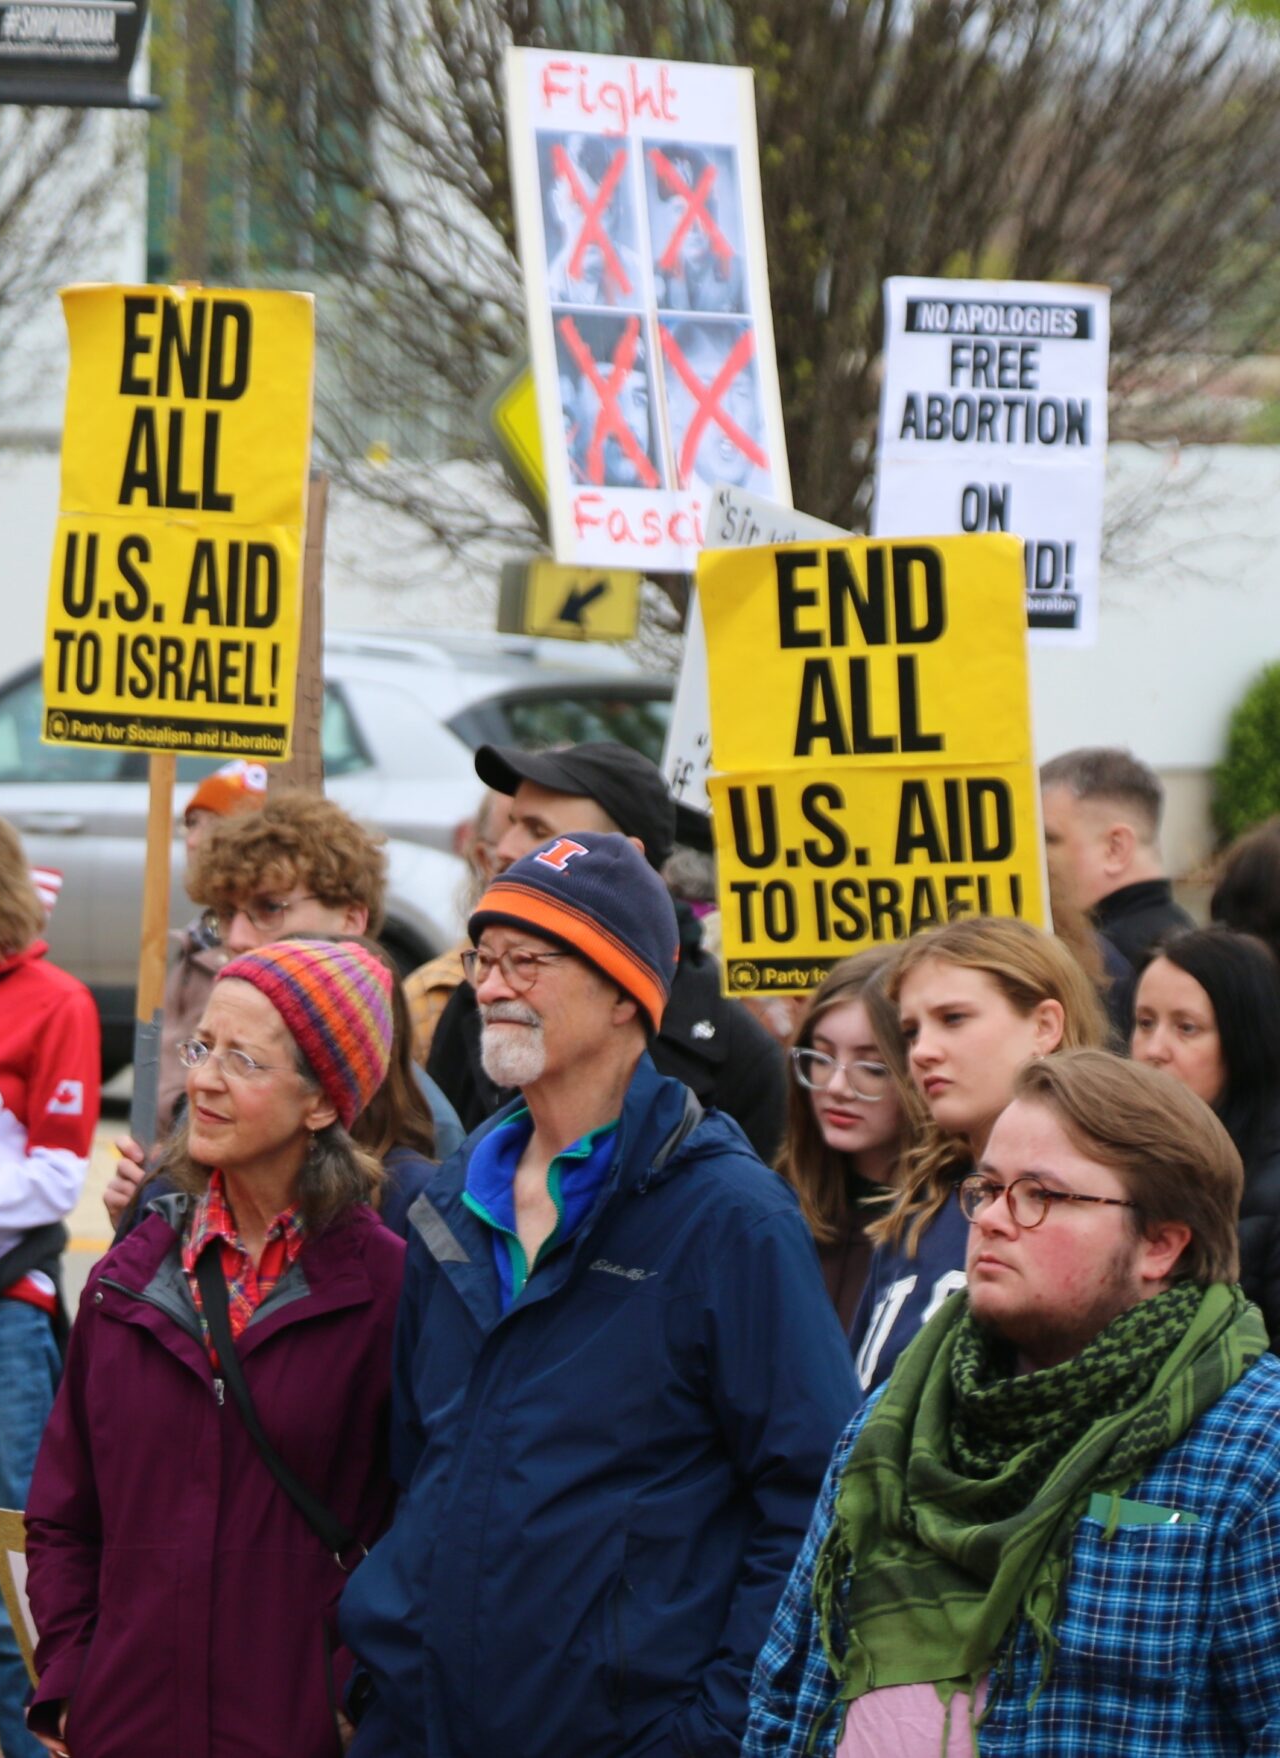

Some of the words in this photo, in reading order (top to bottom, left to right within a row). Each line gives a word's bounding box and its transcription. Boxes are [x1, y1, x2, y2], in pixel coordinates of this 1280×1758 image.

[541, 60, 680, 138] Fight
[118, 294, 254, 402] END
[919, 302, 950, 331] NO
[953, 303, 1079, 338] APOLOGIES
[949, 338, 1043, 391] FREE
[899, 391, 1092, 447] ABORTION
[117, 404, 236, 513] ALL
[960, 480, 1012, 534] ON
[61, 532, 165, 623] U.S.
[182, 538, 281, 629] AID
[773, 543, 950, 650] END
[53, 628, 103, 698] TO
[115, 632, 281, 708] ISRAEL!
[73, 719, 106, 742] Party
[107, 722, 127, 740] for
[128, 723, 192, 745] Socialism
[194, 730, 219, 746] and
[222, 733, 286, 751] Liberation
[793, 653, 946, 758] ALL
[534, 837, 589, 872] I
[727, 780, 872, 869] U.S.
[894, 776, 1016, 867] AID
[730, 879, 800, 944] TO
[765, 969, 810, 987] Party
[812, 969, 829, 984] fo
